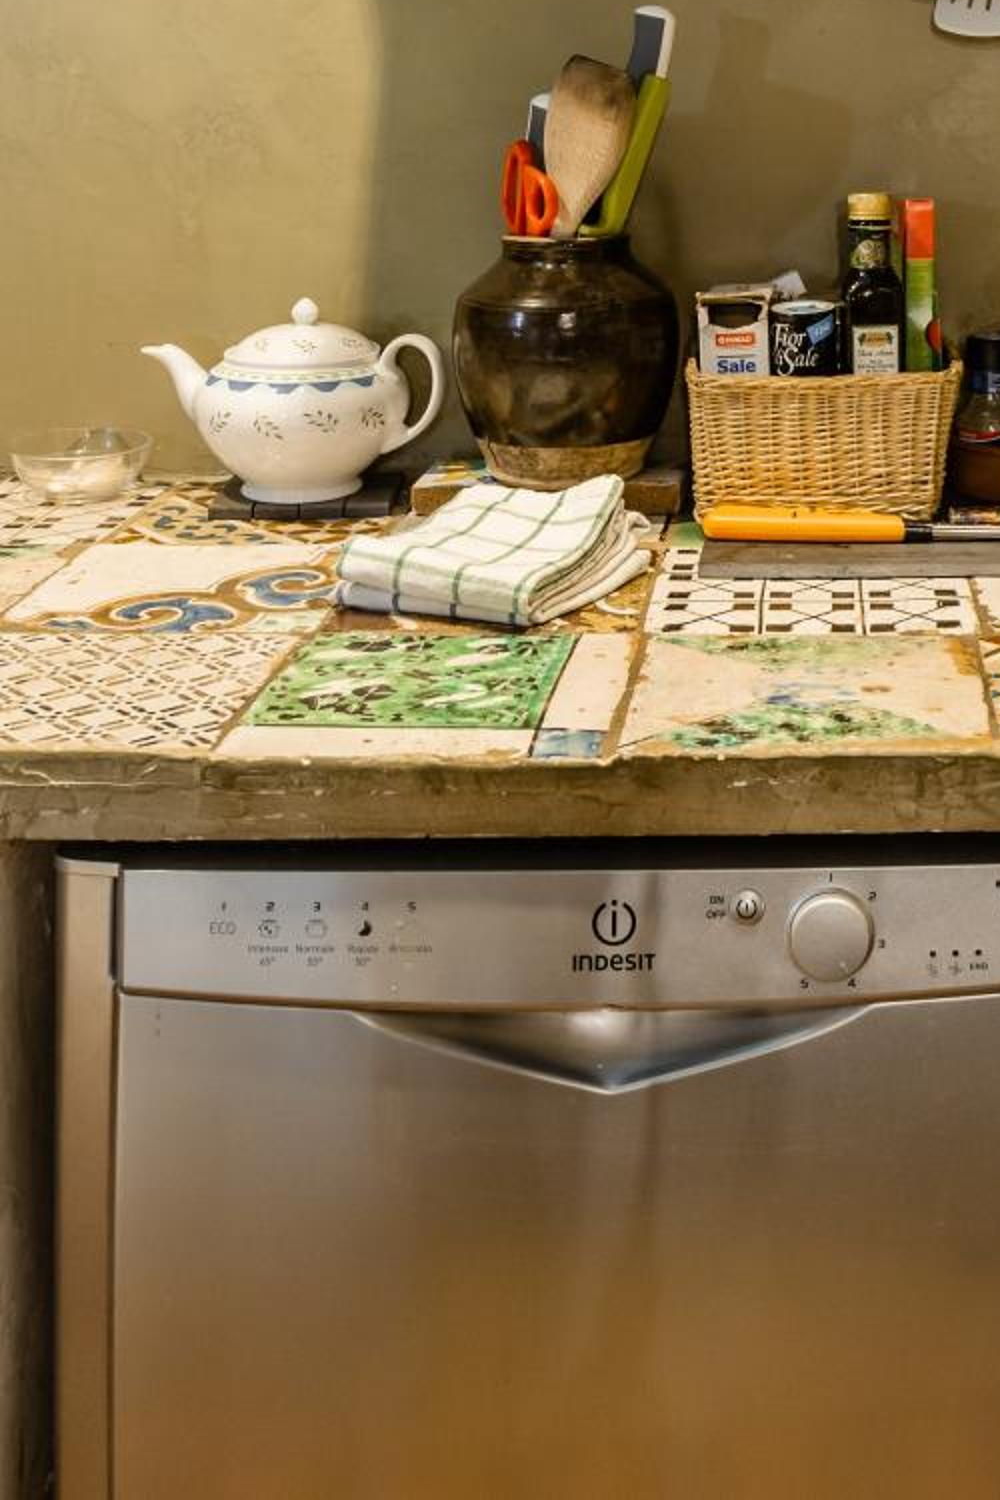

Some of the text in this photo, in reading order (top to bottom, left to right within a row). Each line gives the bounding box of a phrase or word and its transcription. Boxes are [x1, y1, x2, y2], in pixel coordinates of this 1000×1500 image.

[717, 359, 757, 373] Sale
[709, 895, 725, 904] ON
[868, 891, 877, 900] 2
[265, 901, 275, 912] 2
[312, 901, 321, 912] 3
[361, 902, 369, 911] 4
[705, 910, 726, 919] OFF
[209, 922, 236, 935] ECO
[877, 939, 886, 949] 3
[572, 953, 656, 972] INDESIT
[800, 979, 809, 988] 5
[847, 978, 856, 987] 4
